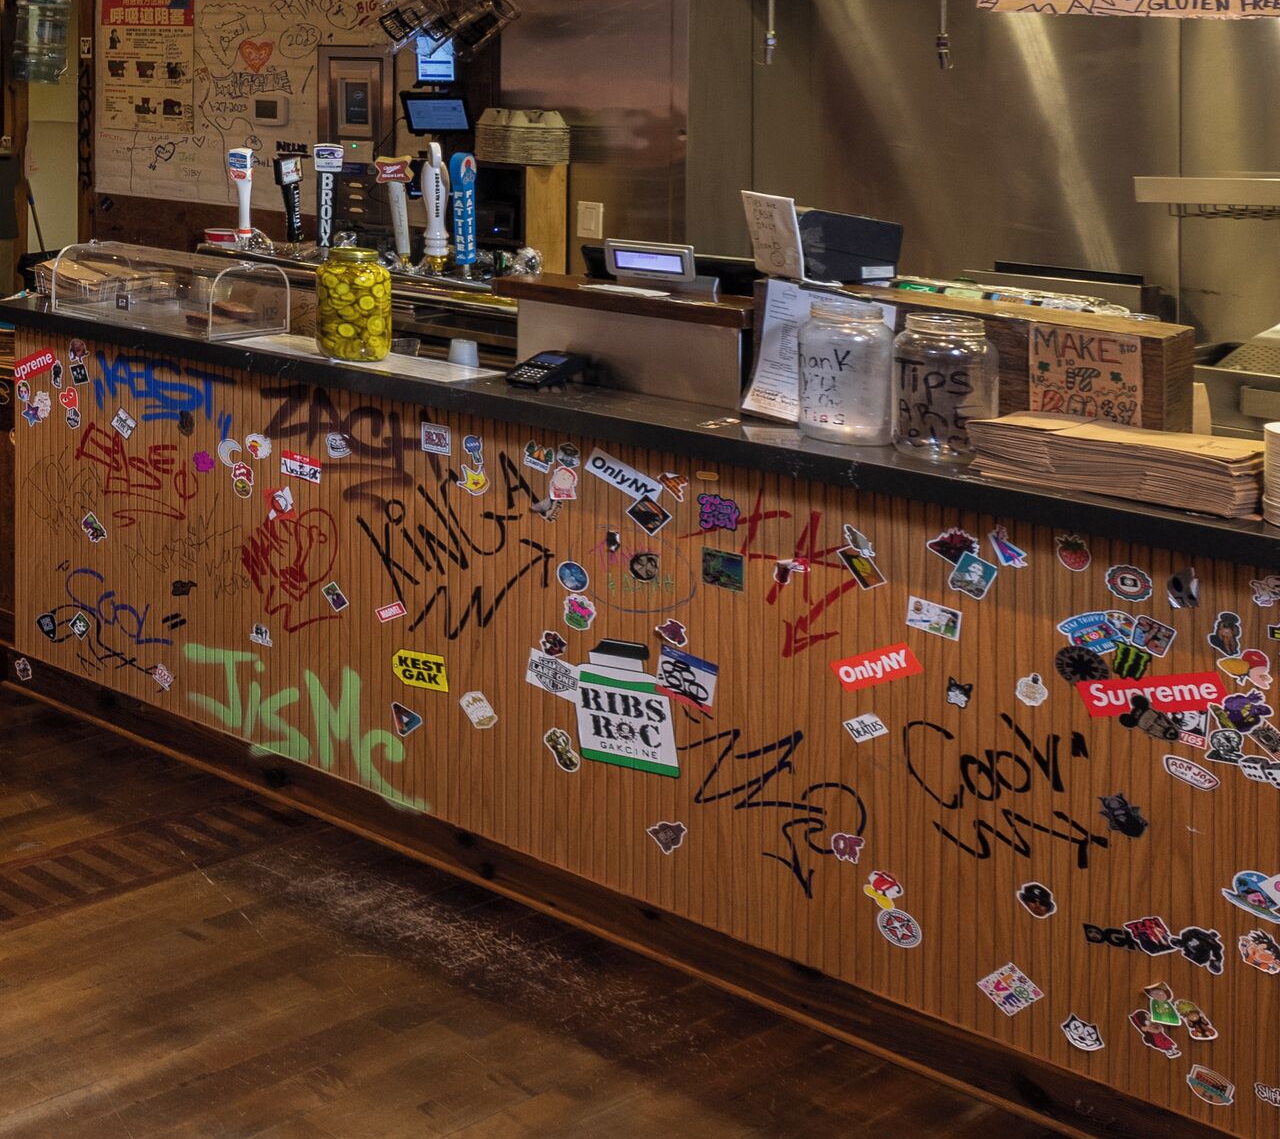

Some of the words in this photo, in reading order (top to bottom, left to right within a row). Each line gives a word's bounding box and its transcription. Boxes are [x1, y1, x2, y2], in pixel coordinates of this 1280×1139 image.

[321, 172, 334, 248] BRONX
[454, 191, 462, 213] FAT
[465, 189, 473, 212] FAT
[455, 219, 466, 251] TIRE
[1034, 326, 1122, 364] MAKE
[590, 455, 657, 497] OnlyNY
[380, 604, 403, 619] MARVEL
[398, 655, 442, 675] KEST
[403, 668, 440, 686] GAK
[838, 649, 907, 685] OnlyNY
[579, 686, 666, 723] RIBS
[1090, 682, 1218, 707] Supreme
[846, 722, 885, 741] BEATLES
[600, 741, 658, 759] GAKCINE
